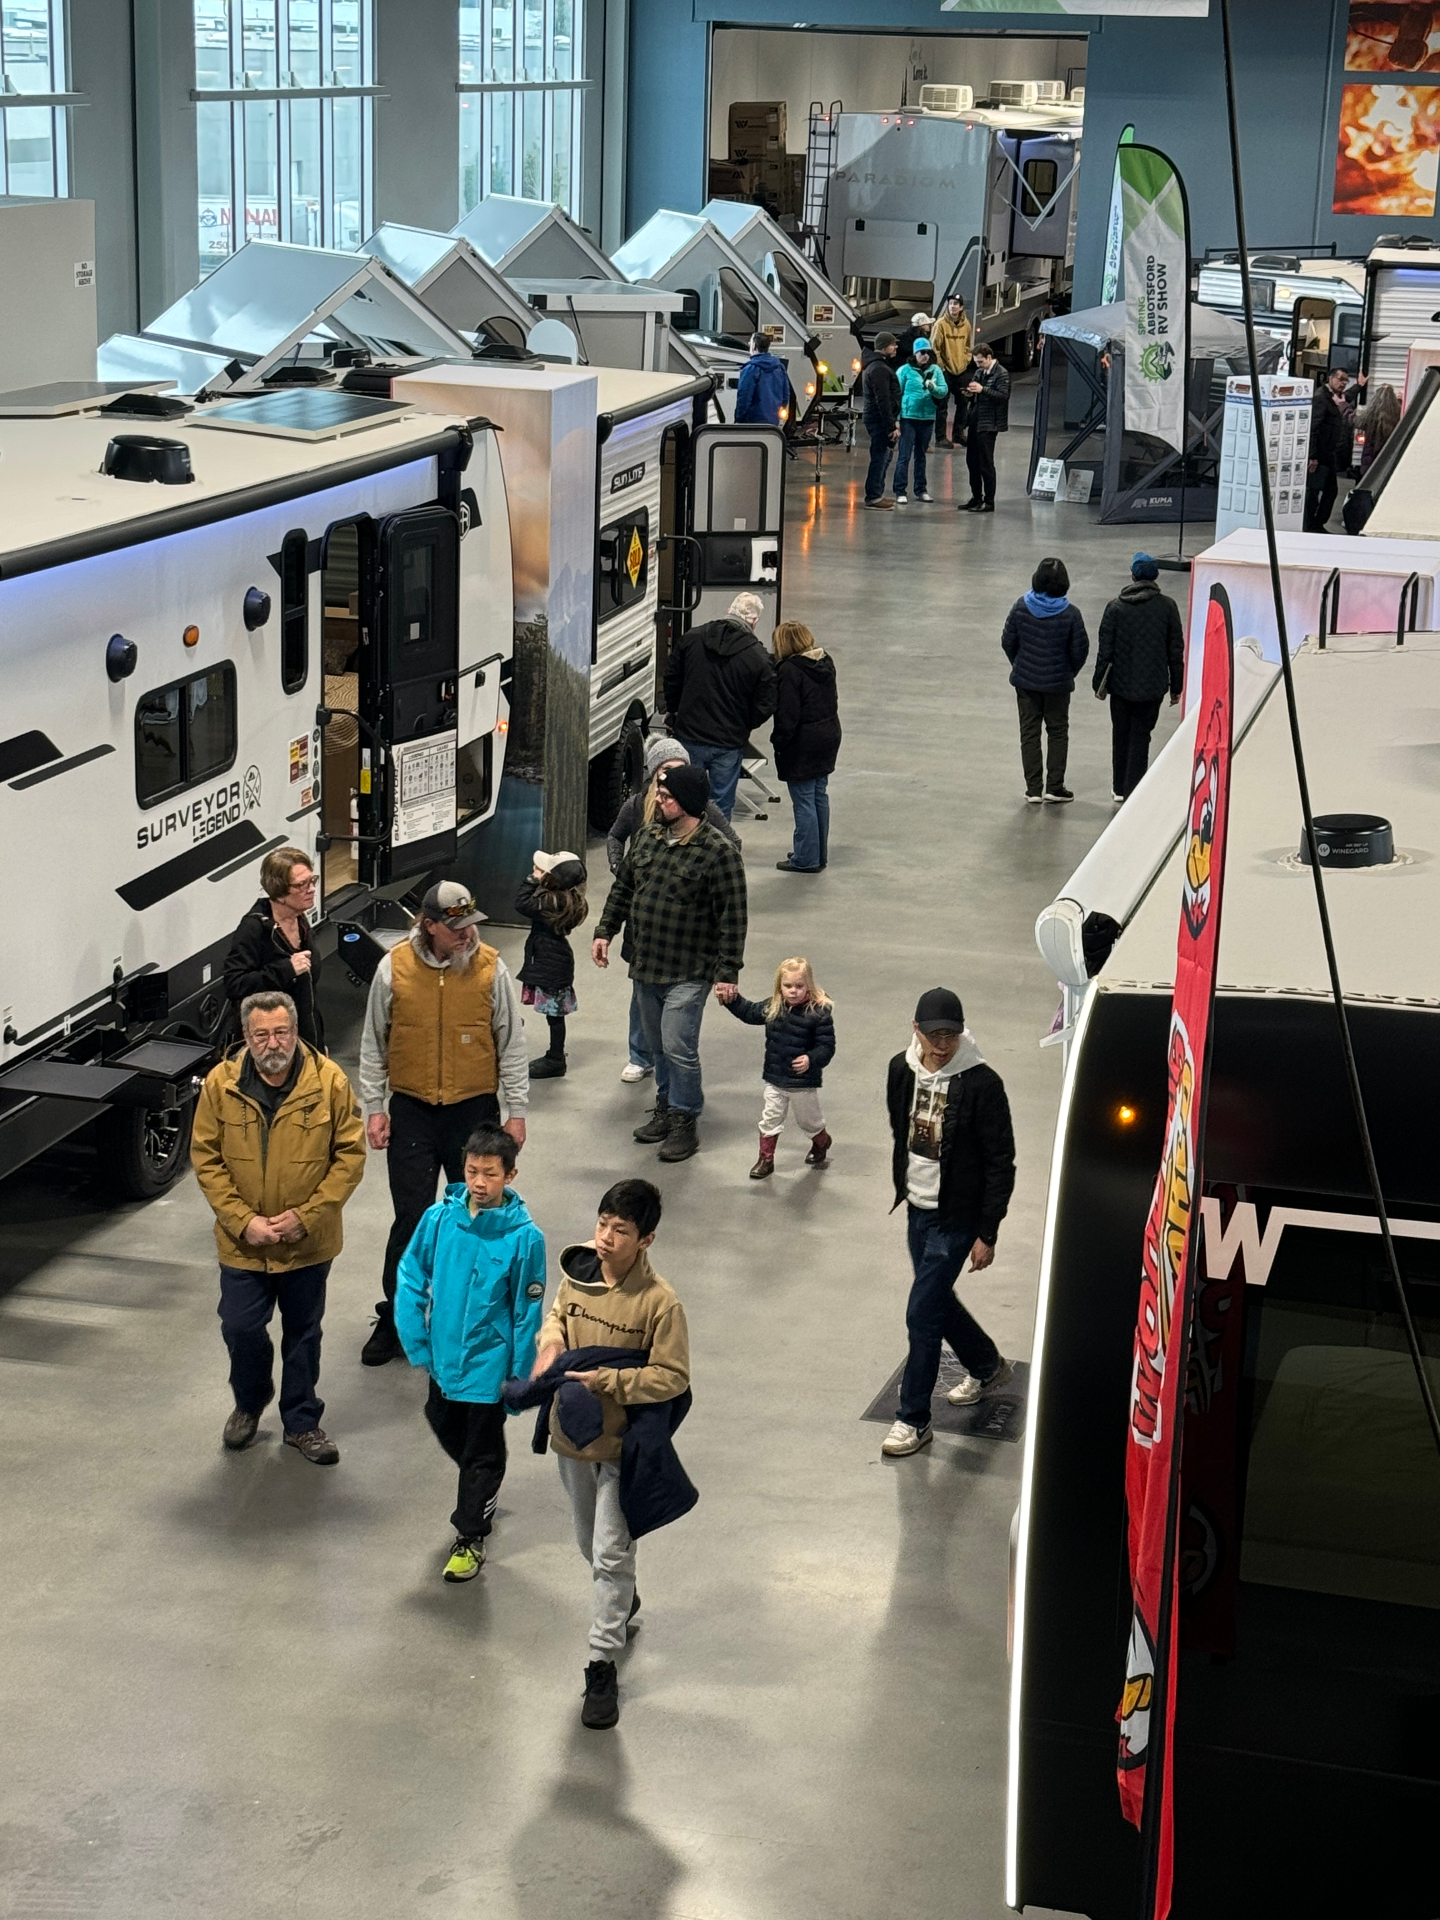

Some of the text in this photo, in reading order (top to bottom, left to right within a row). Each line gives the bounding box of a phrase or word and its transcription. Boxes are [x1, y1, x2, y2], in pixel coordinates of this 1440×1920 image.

[1146, 255, 1156, 336] ABBOTSFORD
[1156, 263, 1169, 335] RV SHOW
[1137, 296, 1146, 336] SPRING
[613, 467, 643, 490] SUN LITE
[1149, 497, 1172, 505] KUMA
[137, 781, 240, 849] SURVEYOR
[192, 803, 240, 843] LEGEND
[567, 1302, 646, 1335] Champion
